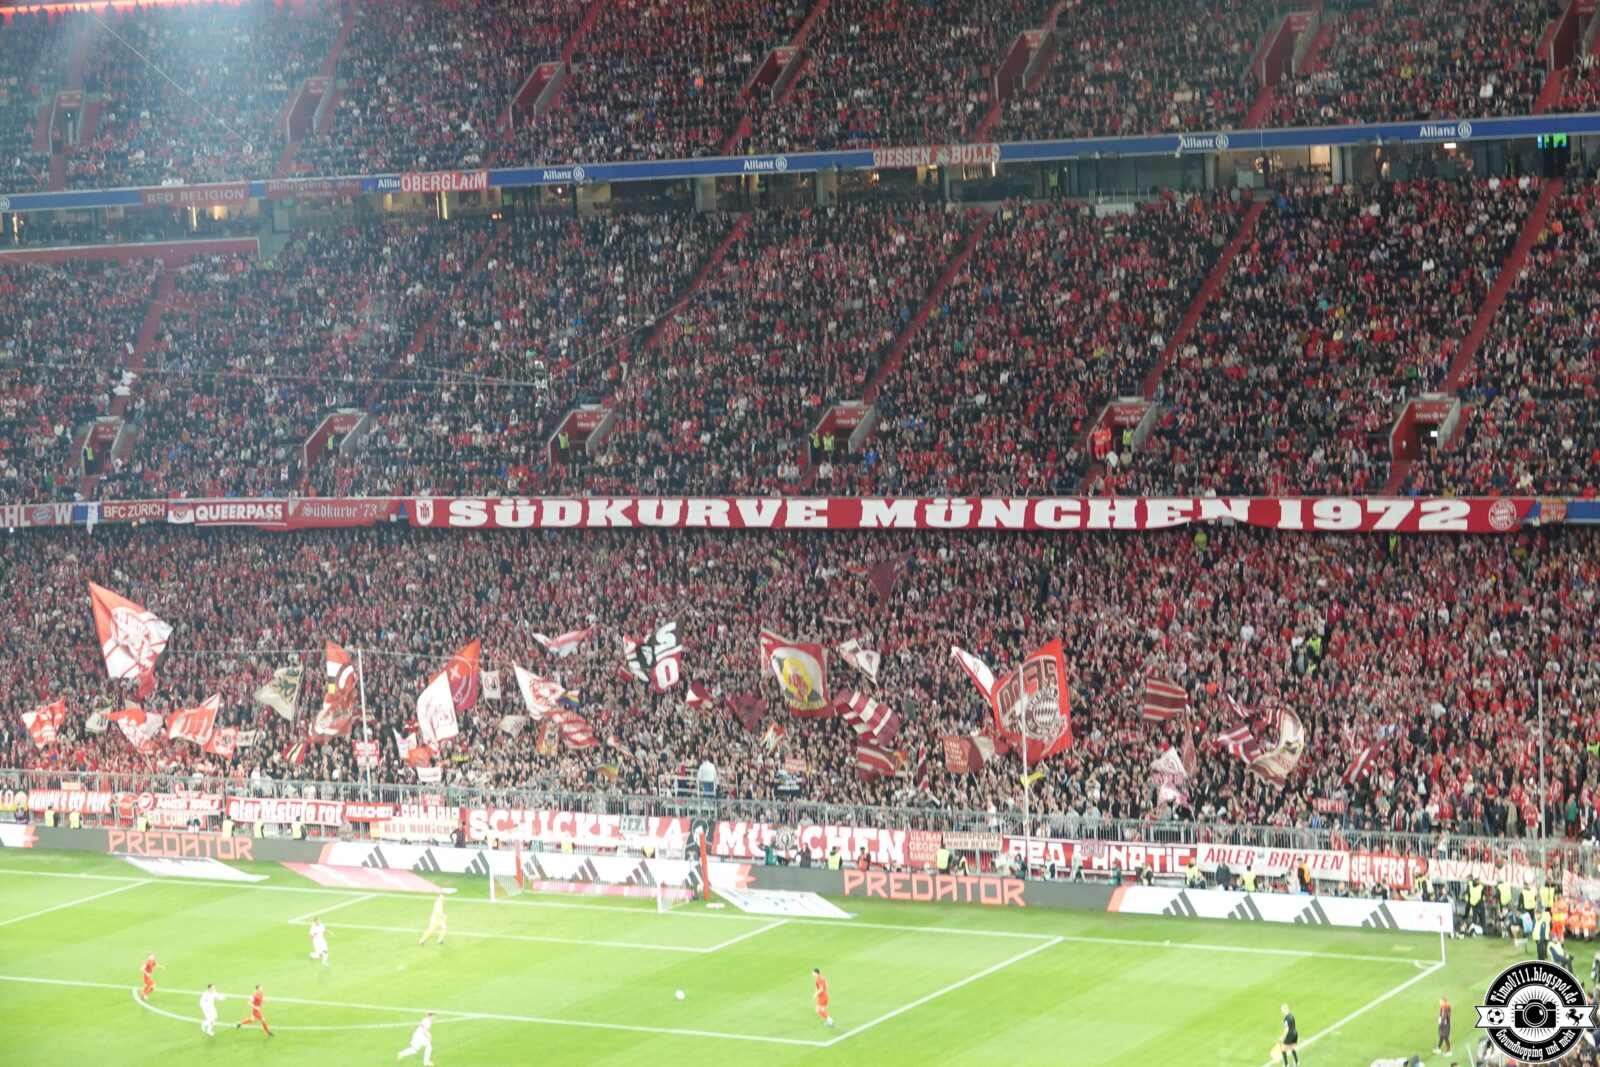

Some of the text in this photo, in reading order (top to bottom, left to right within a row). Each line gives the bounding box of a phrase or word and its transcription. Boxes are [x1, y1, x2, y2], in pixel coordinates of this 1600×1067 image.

[1420, 124, 1456, 138] Allianz
[1180, 136, 1215, 150] Allianz
[743, 159, 774, 170] Allianz
[873, 144, 1000, 168] GIESSEN BULLS
[543, 170, 572, 180] Allianz
[180, 188, 245, 202] RELIGION
[104, 505, 126, 518] BFC
[196, 503, 283, 520] QUEERPASS
[303, 503, 358, 518] Südkurve
[448, 499, 828, 528] SÜDKURVE
[859, 498, 1251, 528] MÜNCHEN
[1277, 498, 1471, 531] 1972
[468, 808, 687, 848] SCHICKEIA
[108, 829, 255, 861] PREDATOR
[1204, 846, 1257, 865] ADLER
[1351, 855, 1406, 886] SELTERS
[843, 869, 1026, 907] PREDATOR
